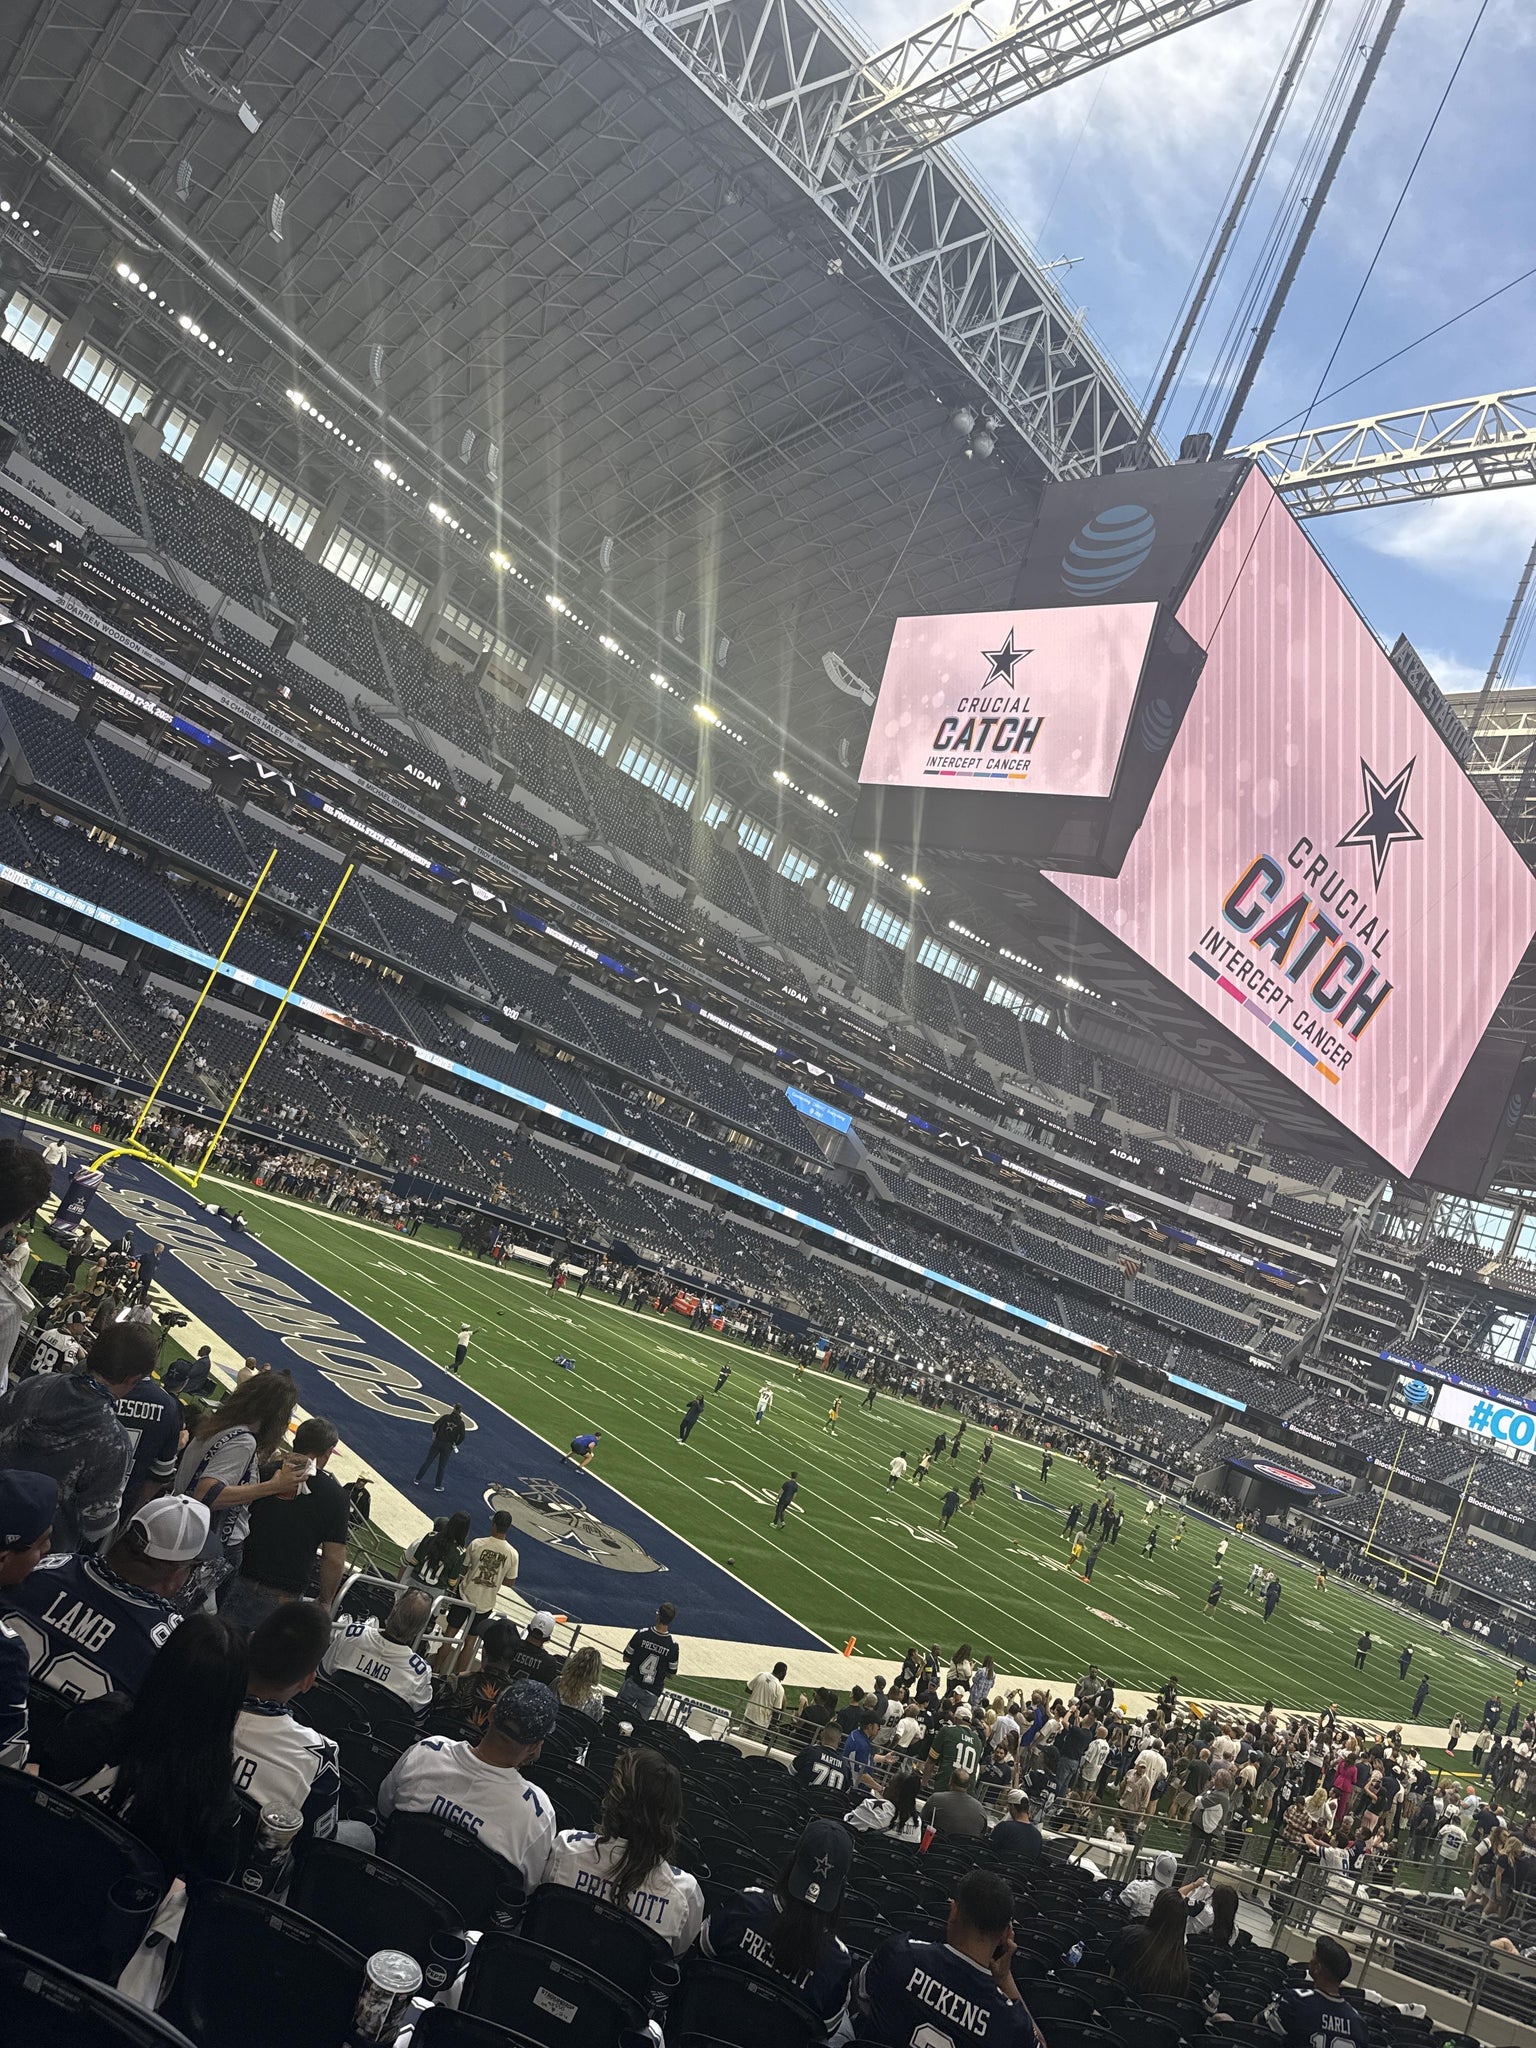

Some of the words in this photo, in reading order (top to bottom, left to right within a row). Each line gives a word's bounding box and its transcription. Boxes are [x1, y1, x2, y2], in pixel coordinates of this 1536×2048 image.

[66, 601, 101, 627] DARREN
[102, 624, 142, 652] WOODSON
[83, 561, 115, 585] OFFICIAL
[117, 583, 149, 607] LUGGAGE
[152, 605, 181, 627] PARTNER
[183, 625, 192, 634] OF
[194, 632, 205, 642] THE
[207, 641, 231, 658] DALLAS
[232, 656, 263, 679] COWBOYS
[93, 671, 135, 704] DECEMBER
[154, 707, 174, 724] 2025
[957, 697, 1030, 713] CRUCIAL
[1392, 640, 1430, 695] AT&T
[1423, 682, 1475, 760] STADIUM
[220, 696, 232, 707] 94
[230, 701, 262, 726] CHARLES
[261, 721, 284, 738] HALEY
[309, 703, 323, 717] THE
[325, 714, 350, 733] WORLD
[351, 730, 359, 739] IS
[360, 737, 389, 757] WAITING
[932, 716, 1045, 754] CATCH
[403, 764, 442, 791] AIDAN
[926, 756, 983, 770] INTERCEPT
[986, 758, 1031, 772] CANCER
[365, 781, 392, 803] MICHAEL
[334, 809, 366, 833] FOOTBALL
[364, 827, 385, 844] STATE
[383, 837, 432, 869] CHAMPIONSHIPS
[482, 812, 539, 848] AIDANTHEBRAND.COM
[1287, 836, 1389, 959] CRUCIAL
[1221, 853, 1394, 1042] CATCH
[716, 948, 727, 958] THE
[727, 955, 745, 967] WORLD
[751, 968, 771, 982] WAITING
[781, 985, 809, 1004] AIDAN
[1199, 926, 1294, 1015] INTERCEPT
[1292, 1010, 1353, 1071] CANCER
[1037, 1116, 1047, 1126] THE
[1048, 1120, 1067, 1134] WORLD
[1074, 1132, 1097, 1146] WAITING
[1109, 1148, 1141, 1166] AIDAN
[1179, 1176, 1237, 1201] AIDANTHEBRAND.COM
[1426, 1260, 1463, 1276] AIDAN
[96, 1180, 479, 1432] COWBOYS
[30, 1344, 59, 1375] 88
[1387, 1355, 1411, 1367] American
[1422, 1367, 1447, 1380] American
[1458, 1379, 1484, 1393] American
[1496, 1393, 1523, 1407] American
[1289, 1423, 1337, 1449] Blockchain.com
[1467, 1496, 1526, 1525] Blockchain.com
[41, 1590, 117, 1653] LAMB
[640, 1639, 670, 1657] PRESCOTT
[355, 1654, 391, 1683] LAMB
[639, 1653, 660, 1686] 4
[820, 1752, 843, 1769] MARTIN
[952, 1742, 977, 1775] 10
[808, 1761, 845, 1790] 70
[430, 1794, 485, 1836] DIGGS
[522, 1787, 544, 1818] 7
[243, 1874, 262, 1886] PEPSI
[575, 1870, 670, 1924] PREOTT
[426, 1968, 447, 1982] PEPSI
[905, 1967, 991, 2037] PICKENS
[1321, 2013, 1352, 2035] SARLI
